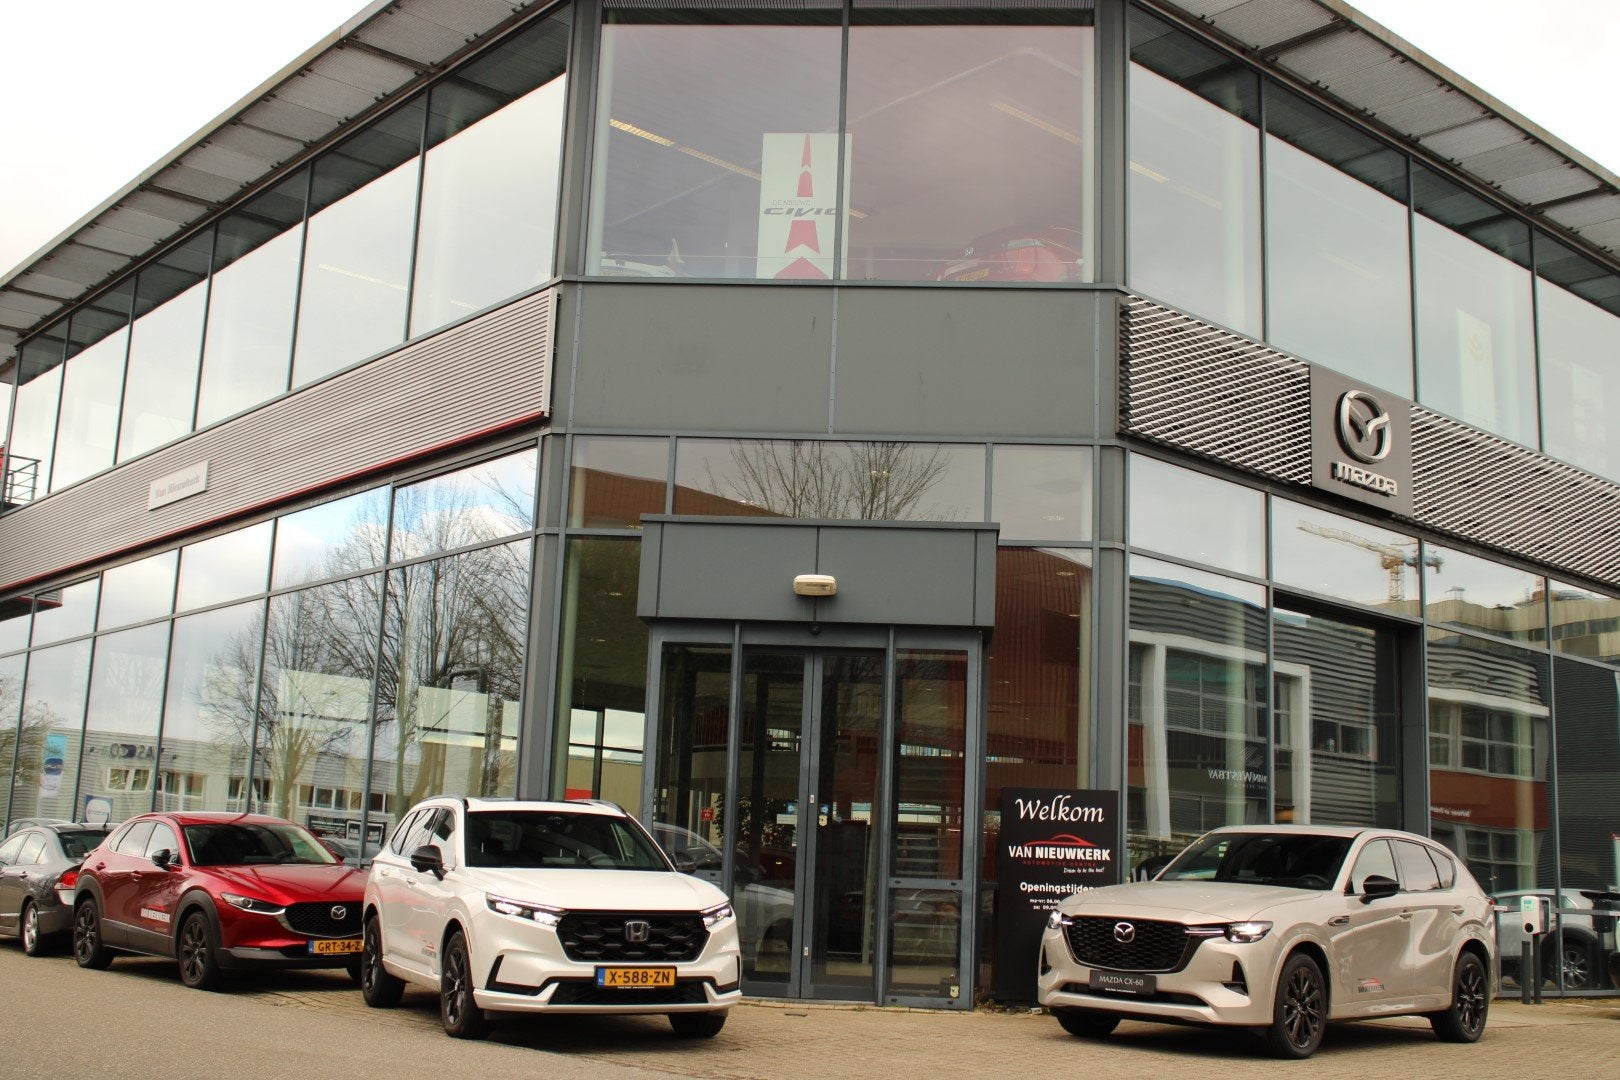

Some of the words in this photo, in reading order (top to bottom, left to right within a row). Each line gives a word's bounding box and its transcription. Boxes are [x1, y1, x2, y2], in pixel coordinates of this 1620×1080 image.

[764, 208, 836, 217] CIVIC
[1015, 795, 1104, 822] Welkom
[1008, 845, 1032, 859] VAN
[1035, 847, 1111, 860] NIEUWKERK
[317, 941, 360, 951] GRT-34-Z
[609, 971, 670, 983] X-588-ZN
[1099, 975, 1123, 984] MAZDA
[1124, 977, 1144, 986] CX-60
